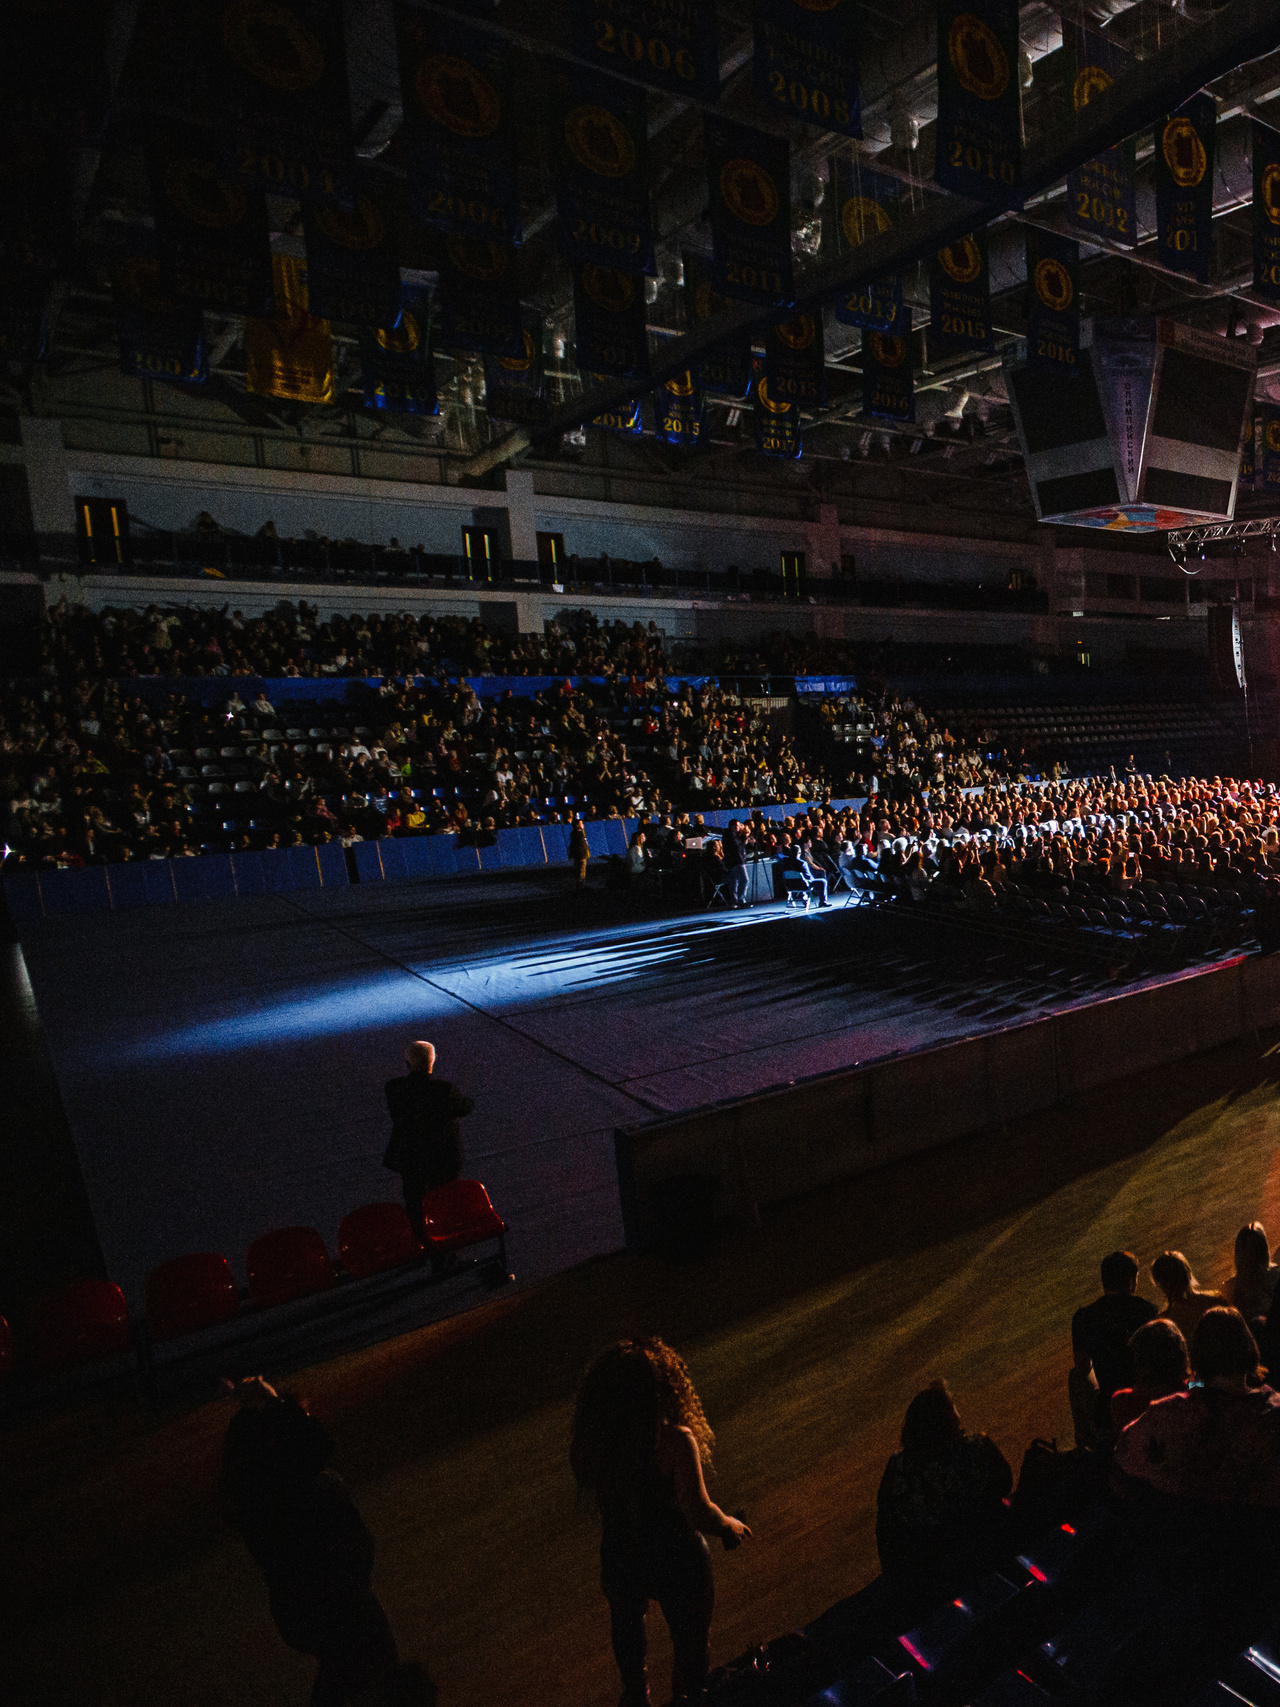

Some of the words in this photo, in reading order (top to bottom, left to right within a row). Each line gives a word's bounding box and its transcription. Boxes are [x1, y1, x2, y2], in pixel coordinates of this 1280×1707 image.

[594, 19, 697, 82] 2006
[769, 71, 851, 124] 2008
[948, 141, 1015, 185] 2010
[428, 189, 508, 231] 2006
[1076, 192, 1128, 234] 2012
[572, 217, 642, 254] 2009
[726, 261, 783, 294] 2011
[844, 292, 897, 322] 2013
[940, 314, 986, 340] 2015
[1037, 338, 1076, 366] 2016
[776, 376, 819, 400] 2015
[870, 390, 909, 411] 2016
[663, 416, 700, 437] 2015
[762, 436, 796, 452] 2017
